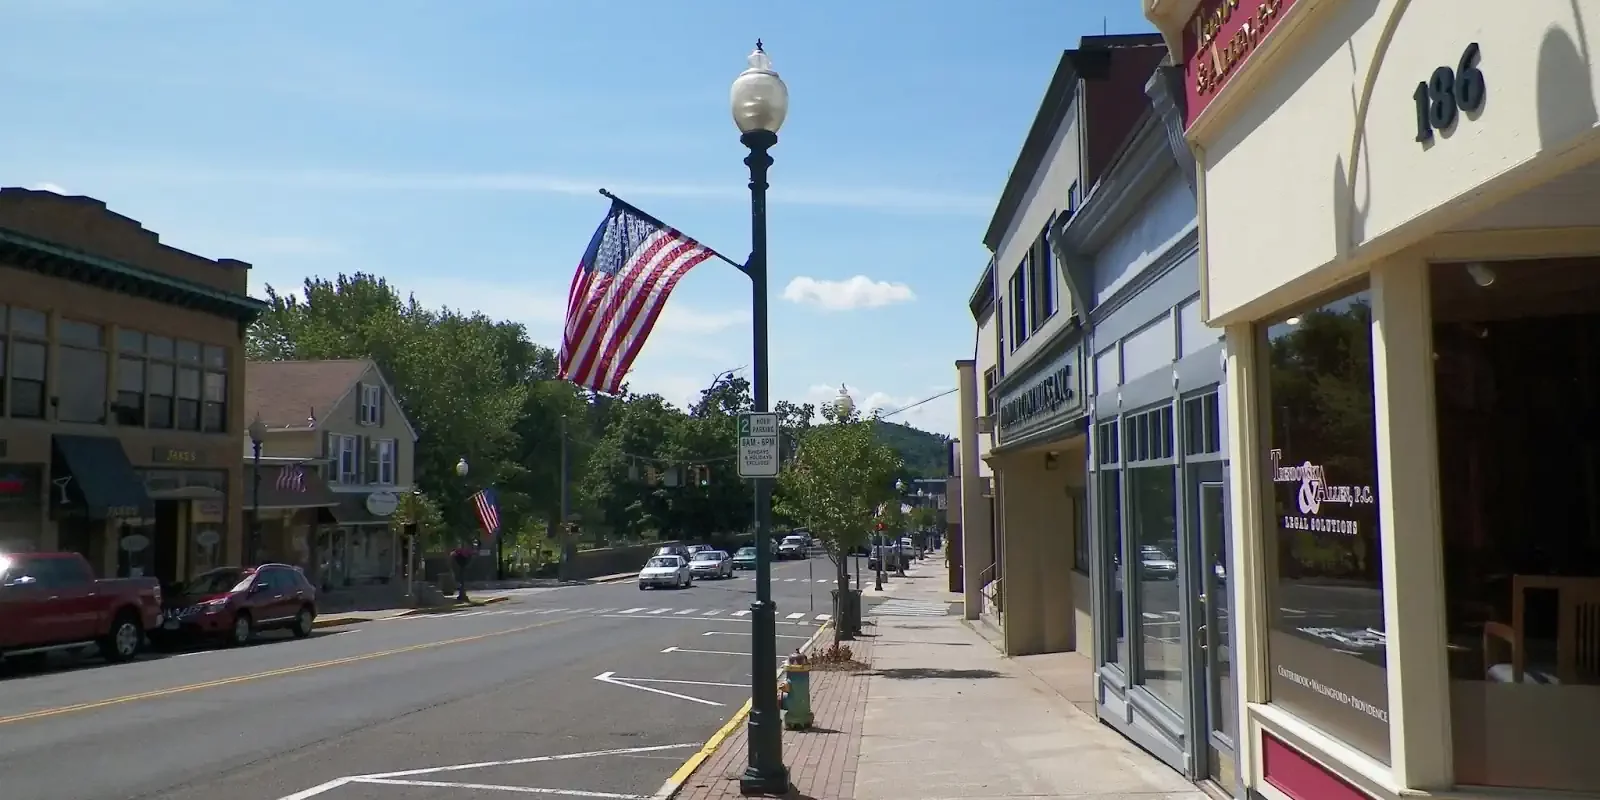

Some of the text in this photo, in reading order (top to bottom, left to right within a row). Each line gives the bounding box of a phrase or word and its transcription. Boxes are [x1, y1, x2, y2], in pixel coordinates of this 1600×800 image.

[1413, 42, 1486, 142] 186
[741, 418, 750, 433] 2
[1299, 461, 1320, 514] &
[1284, 516, 1358, 535] LEGAL SOLUTIONS
[1351, 695, 1388, 723] PROVIDENCE
